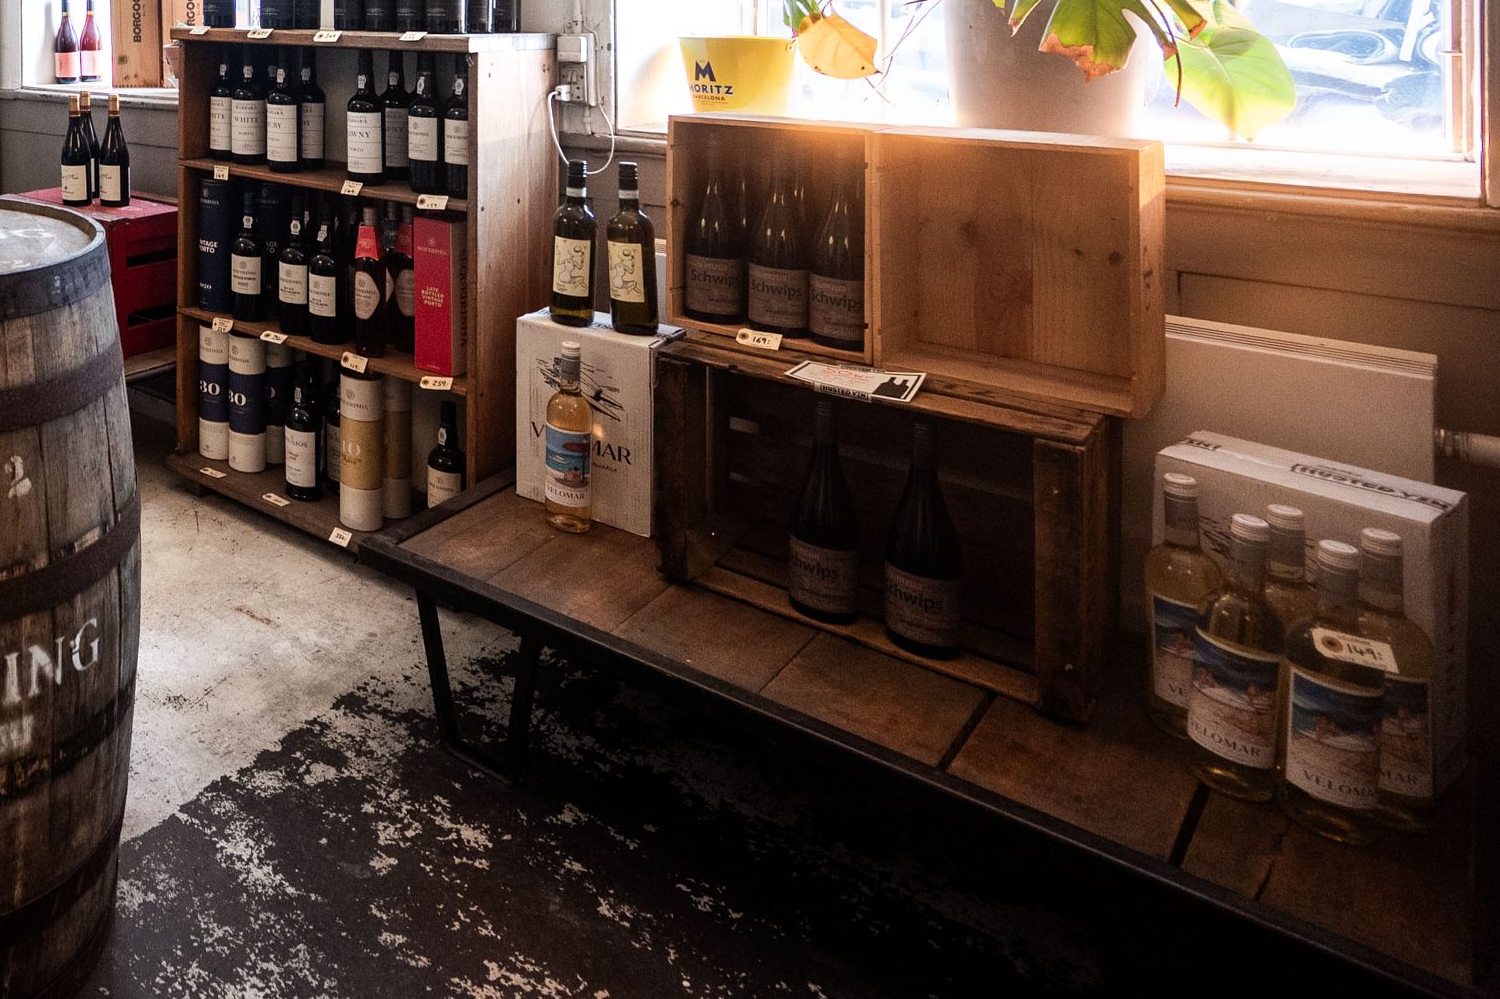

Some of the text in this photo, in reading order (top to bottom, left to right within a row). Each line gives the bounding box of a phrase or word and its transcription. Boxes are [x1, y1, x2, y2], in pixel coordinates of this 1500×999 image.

[694, 60, 717, 82] M
[751, 279, 803, 300] Schwips
[811, 290, 862, 312] Schwips
